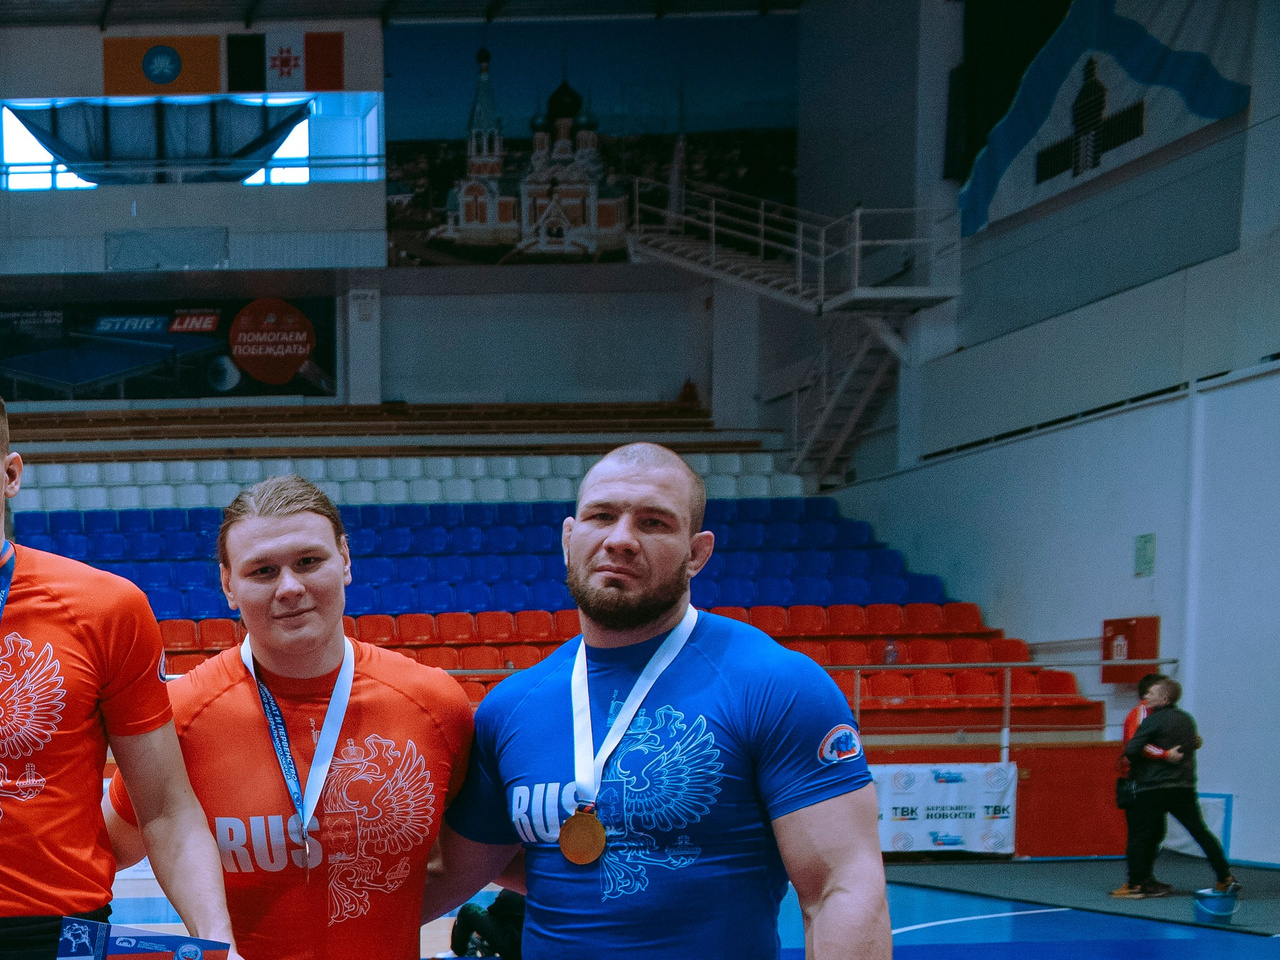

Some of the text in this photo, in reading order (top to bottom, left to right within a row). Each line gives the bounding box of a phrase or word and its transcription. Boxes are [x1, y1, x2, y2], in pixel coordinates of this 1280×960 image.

[172, 315, 214, 330] LINE
[237, 331, 307, 343] ПОМОГАЕМ
[232, 344, 310, 357] ПОБЕЖДАТЬ!
[274, 723, 300, 781] ПЕРВЕНСТВО
[925, 811, 976, 820] НОВОСТИ
[215, 814, 323, 873] RUS
